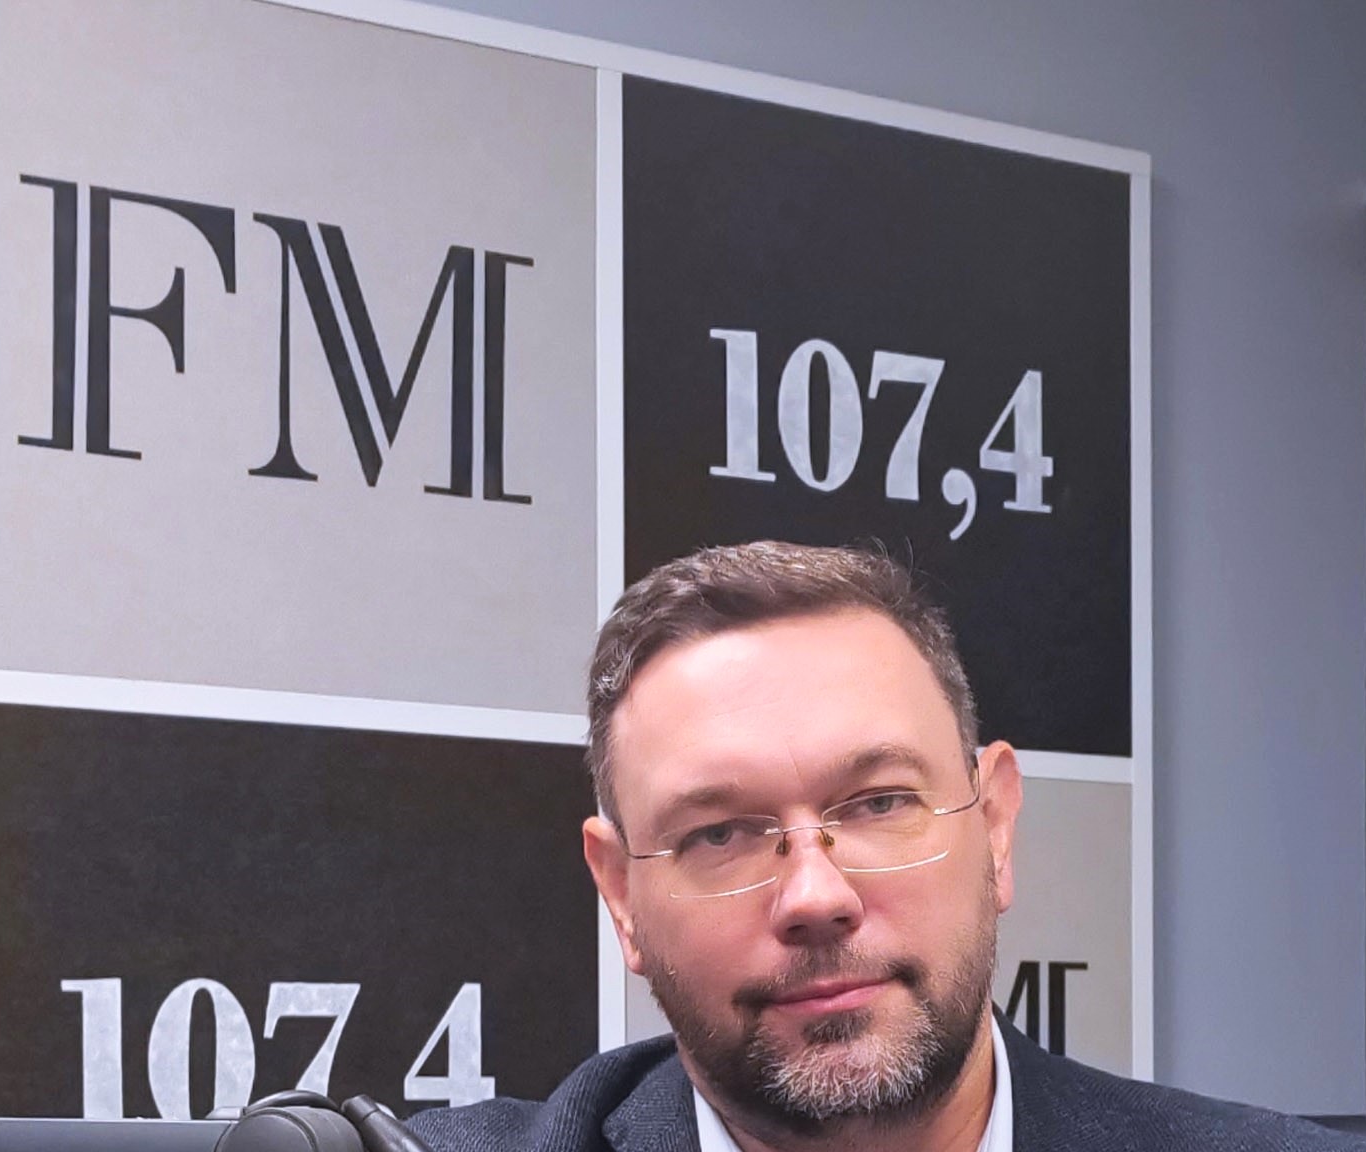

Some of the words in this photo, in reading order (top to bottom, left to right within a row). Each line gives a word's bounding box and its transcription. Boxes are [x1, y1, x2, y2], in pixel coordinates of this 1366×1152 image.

[17, 173, 534, 506] FM
[708, 326, 1054, 541] 107,4
[60, 976, 497, 1121] 1074
